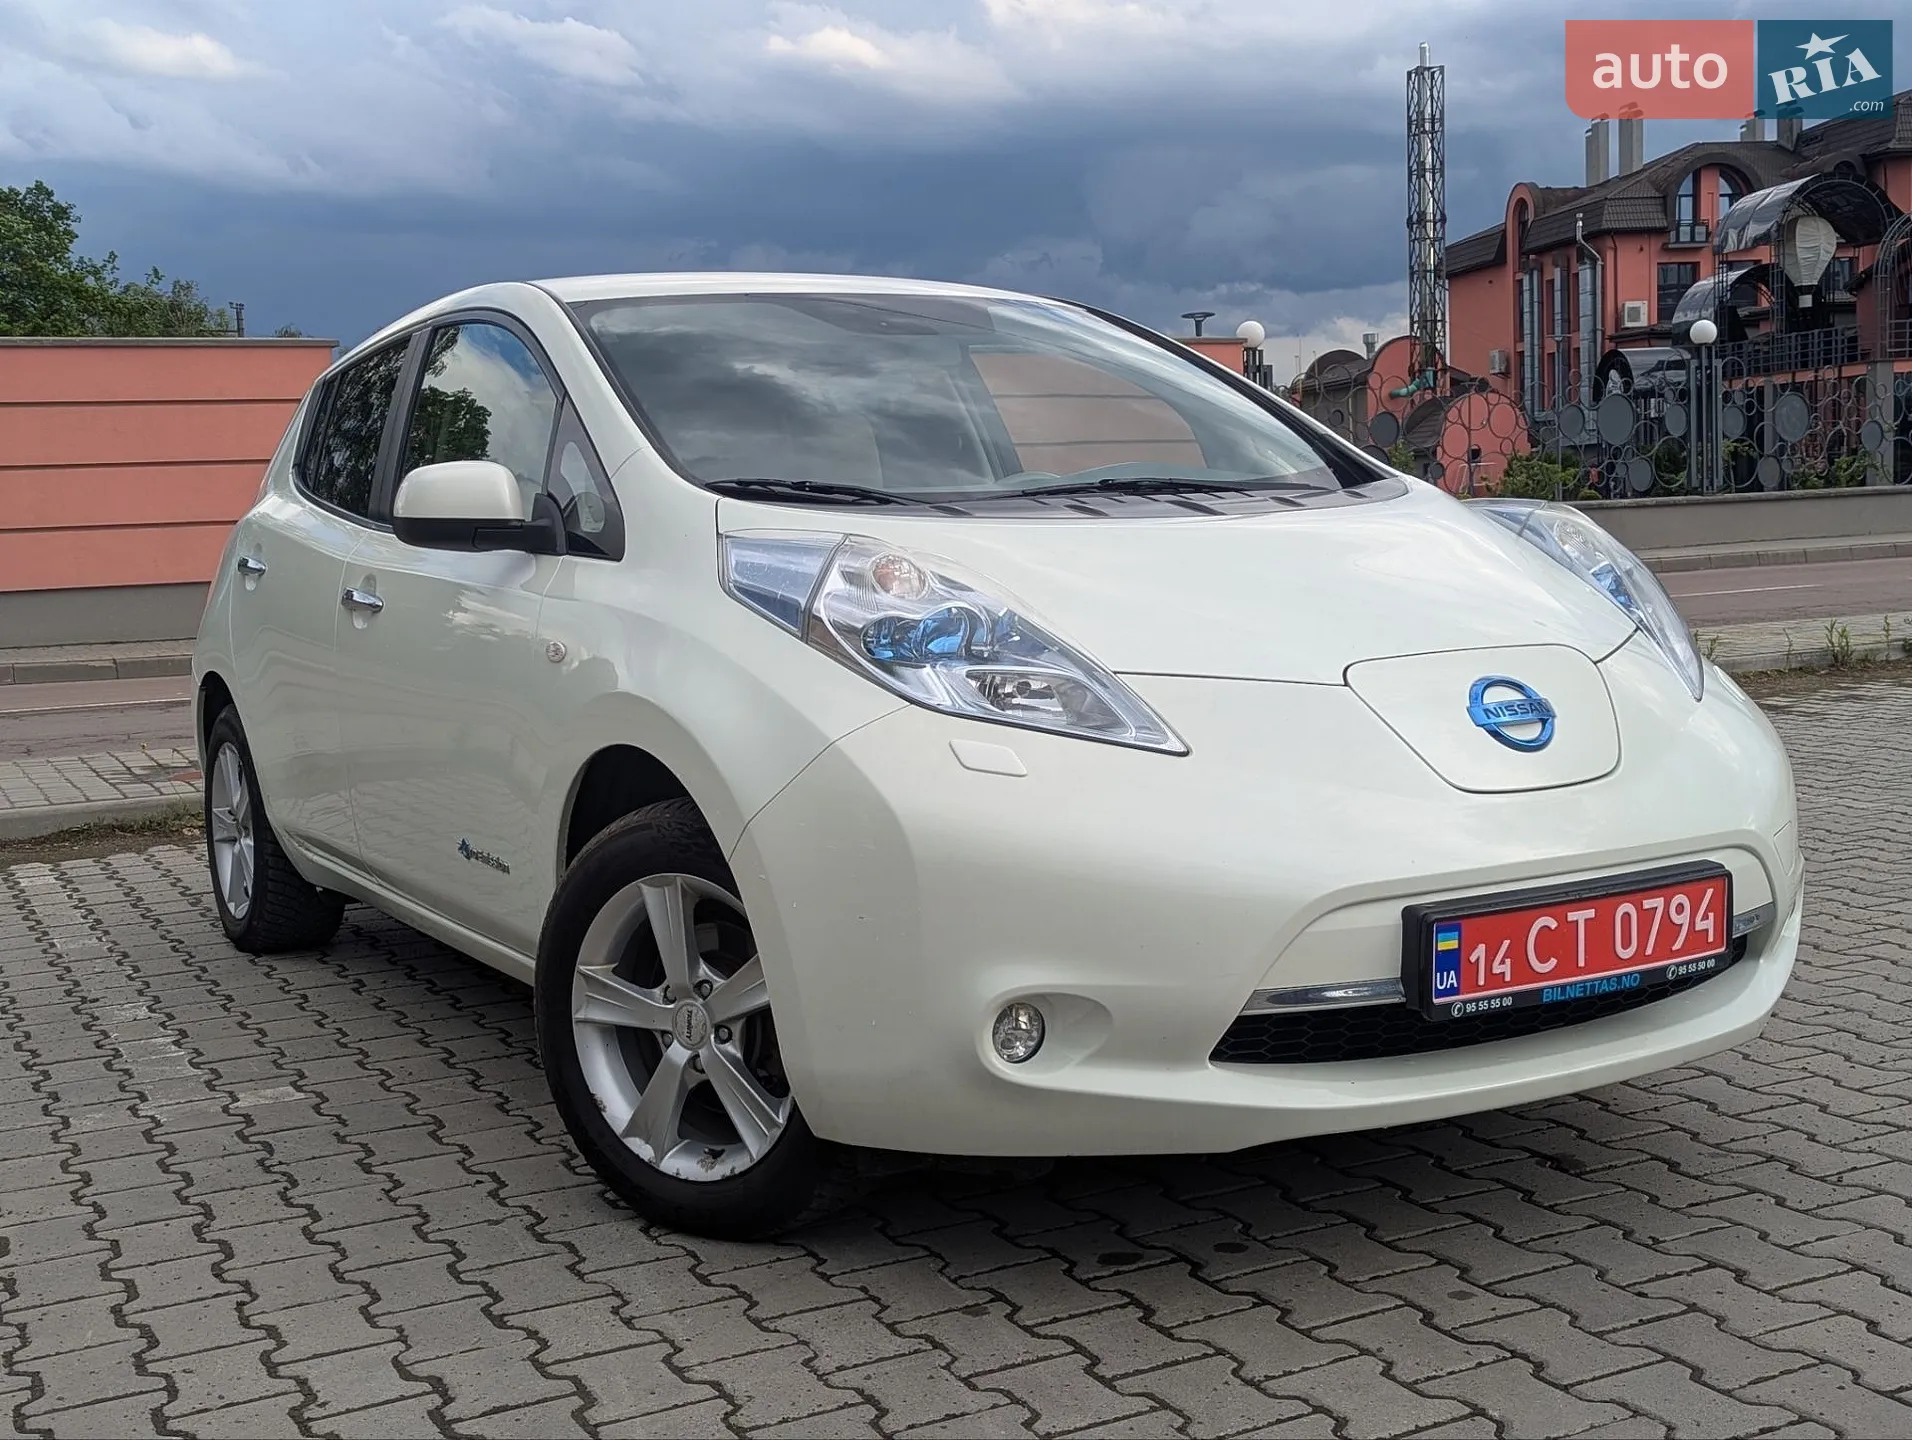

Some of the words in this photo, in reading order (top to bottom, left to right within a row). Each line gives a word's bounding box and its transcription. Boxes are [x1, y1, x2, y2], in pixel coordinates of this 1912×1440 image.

[1482, 701, 1551, 719] NISSAN
[1469, 939, 1512, 986] 14
[1526, 908, 1596, 974] CT
[1614, 888, 1715, 960] 0794
[1436, 970, 1458, 990] UA
[1542, 973, 1641, 1002] BILNETTAS.NO
[1465, 1002, 1477, 1013] 95
[1478, 1000, 1489, 1011] 55
[1489, 998, 1501, 1009] 55
[1502, 996, 1513, 1007] 00
